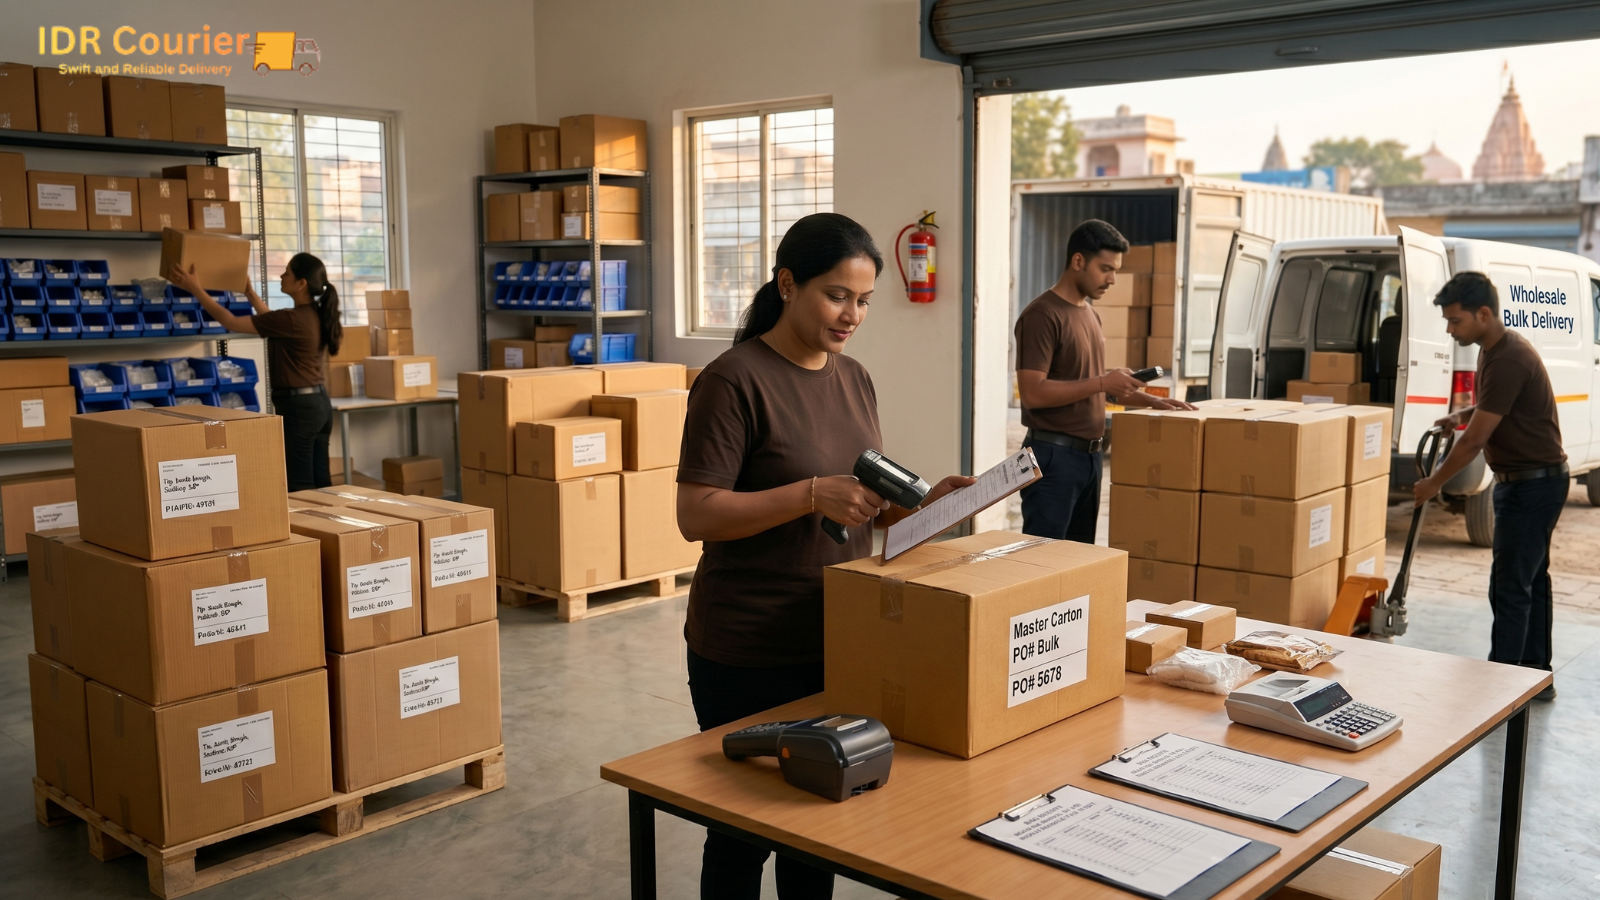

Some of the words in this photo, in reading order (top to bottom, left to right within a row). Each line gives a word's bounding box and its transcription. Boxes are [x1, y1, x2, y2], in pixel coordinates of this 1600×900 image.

[1509, 284, 1567, 306] Wholesale
[1503, 309, 1530, 328] Bulk
[1532, 311, 1574, 334] Delivery
[1013, 617, 1049, 640] Master
[1050, 607, 1083, 627] Carton
[1013, 641, 1035, 664] PO#
[1037, 634, 1060, 656] Bulk
[1012, 674, 1036, 697] PO#
[1037, 665, 1062, 688] 5678
